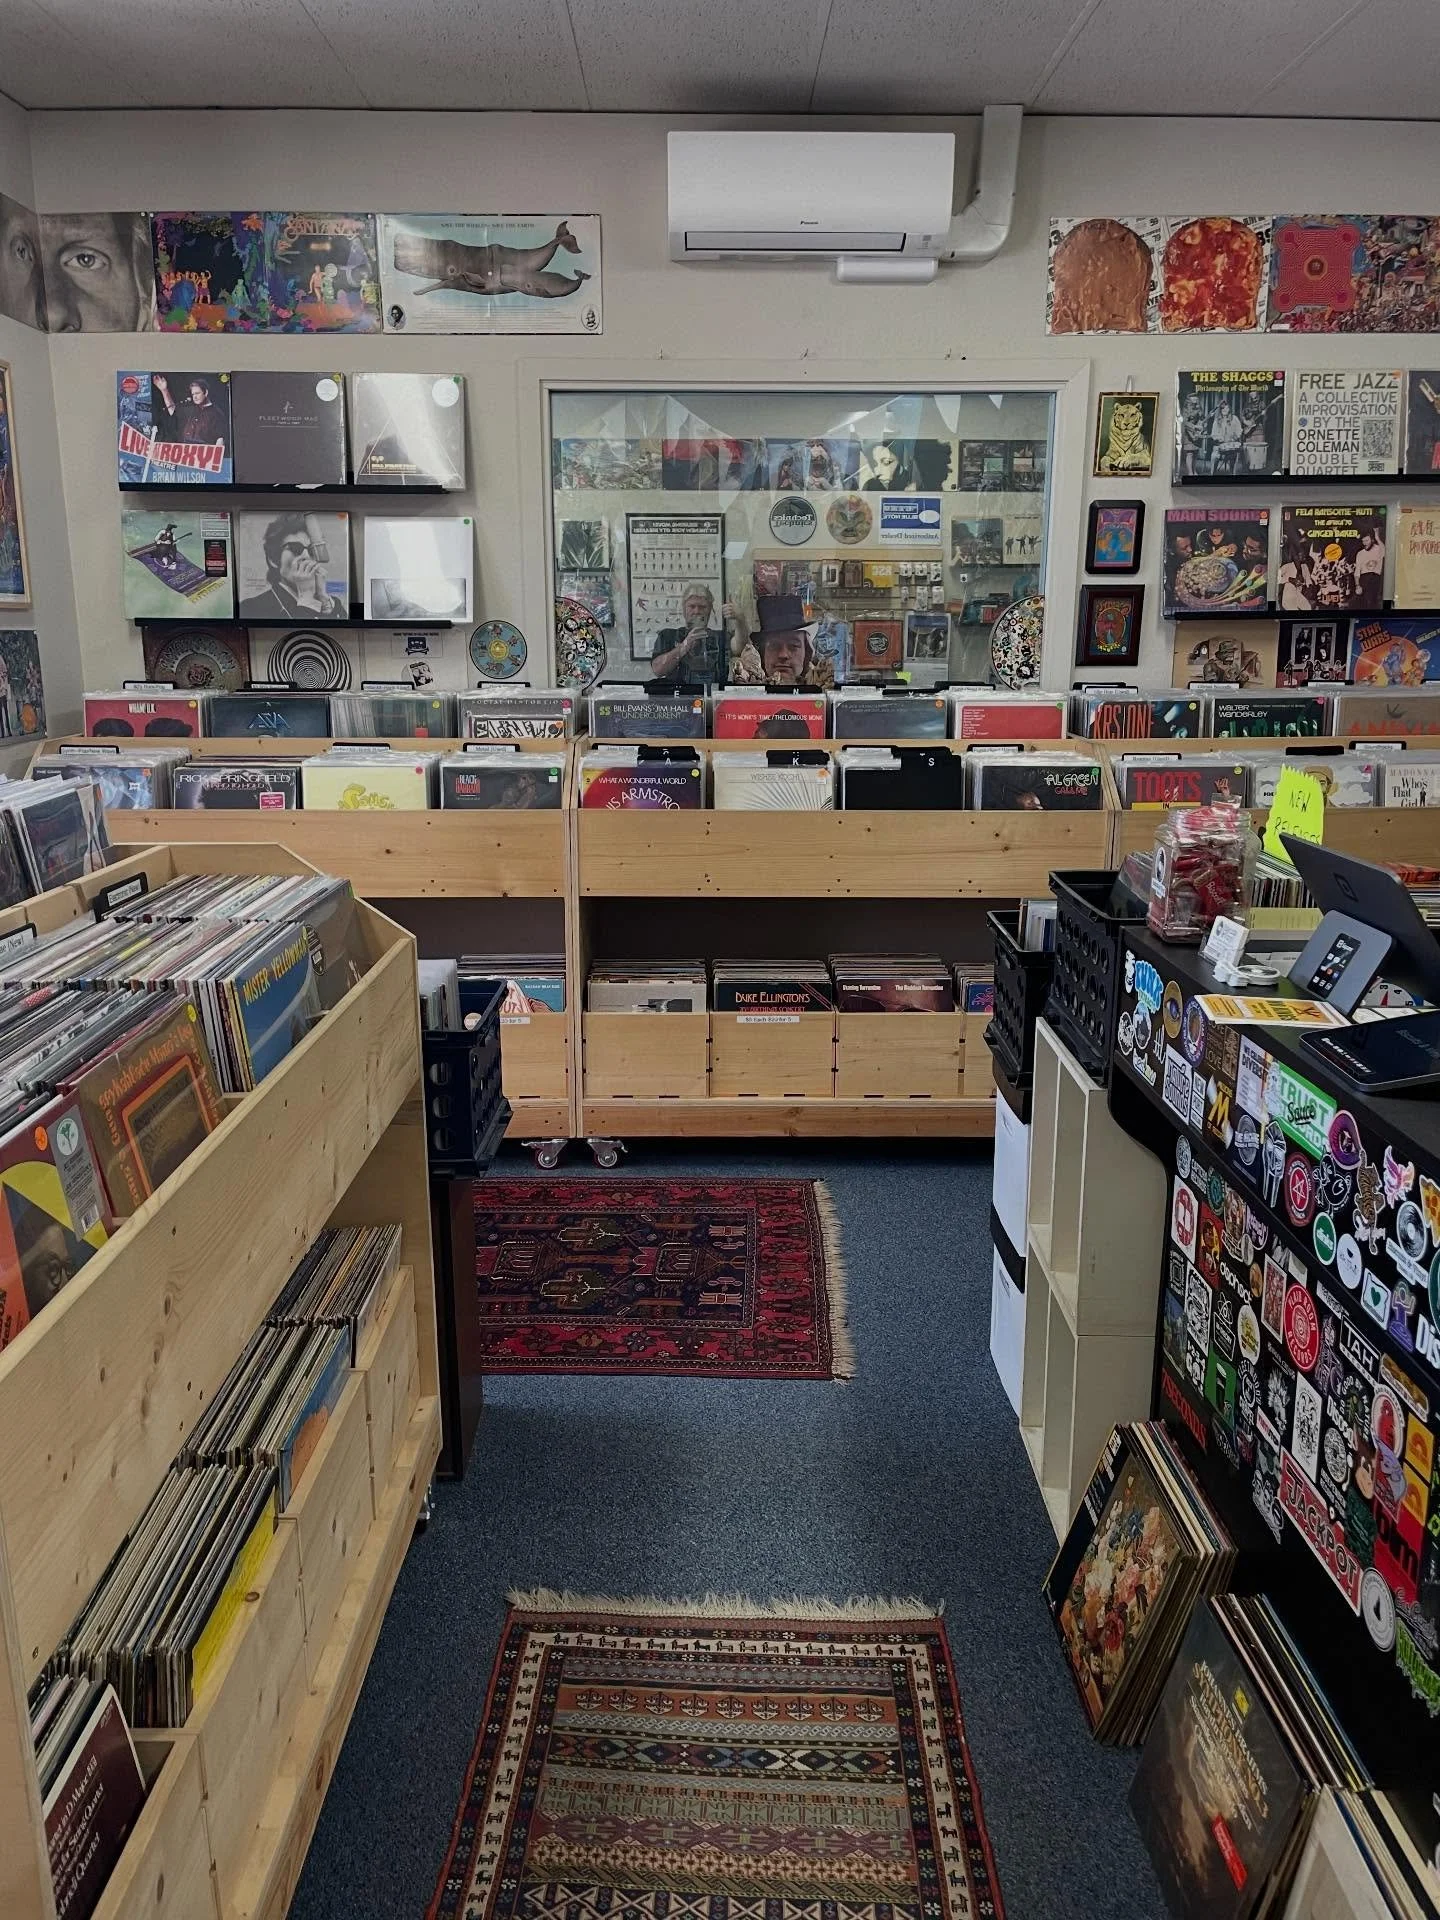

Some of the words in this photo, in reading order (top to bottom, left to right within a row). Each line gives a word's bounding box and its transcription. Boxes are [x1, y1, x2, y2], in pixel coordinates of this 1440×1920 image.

[1191, 372, 1218, 382] THE
[1221, 372, 1273, 382] SHAGGS
[1299, 373, 1344, 389] FREE
[1354, 372, 1399, 389] JAZZ
[1230, 384, 1237, 392] of
[1238, 384, 1249, 392] The
[1250, 384, 1269, 392] World
[1299, 392, 1308, 404] A
[1315, 392, 1398, 404] COLLECTIVE
[1298, 404, 1397, 416] IMPROVISATION
[1313, 417, 1331, 428] BY
[1336, 417, 1360, 428] THE
[1297, 429, 1360, 441] ORNETTE
[1297, 441, 1360, 453] COLEMAN
[159, 443, 224, 472] ROXY!
[1296, 453, 1359, 465] DOUBLE
[1296, 466, 1359, 475] QUARTET
[152, 471, 175, 483] BRIAN
[176, 472, 206, 483] WILSON
[1167, 510, 1206, 522] MAIN
[1296, 508, 1313, 516] FELA
[1308, 530, 1333, 539] GINGER
[674, 690, 680, 698] E
[613, 704, 626, 712] BILL
[670, 704, 689, 712] HALL
[622, 711, 682, 719] UNDERCURRENT
[665, 757, 671, 766] A
[928, 758, 935, 766] S
[179, 774, 209, 783] RICK
[210, 774, 291, 783] SPRINGFIELD
[623, 777, 662, 785] WONDERFUL
[1401, 776, 1428, 789] Who's
[1134, 771, 1202, 803] TOOTS
[1392, 786, 1411, 798] That
[621, 787, 680, 810] ARMSTRO
[1289, 790, 1311, 813] NEW
[242, 969, 271, 1006] MISTER
[1380, 982, 1389, 991] 3
[735, 991, 758, 1003] DUKE
[760, 991, 811, 1003] ELLINGTON'S
[1285, 1460, 1359, 1588] JACKPOT
